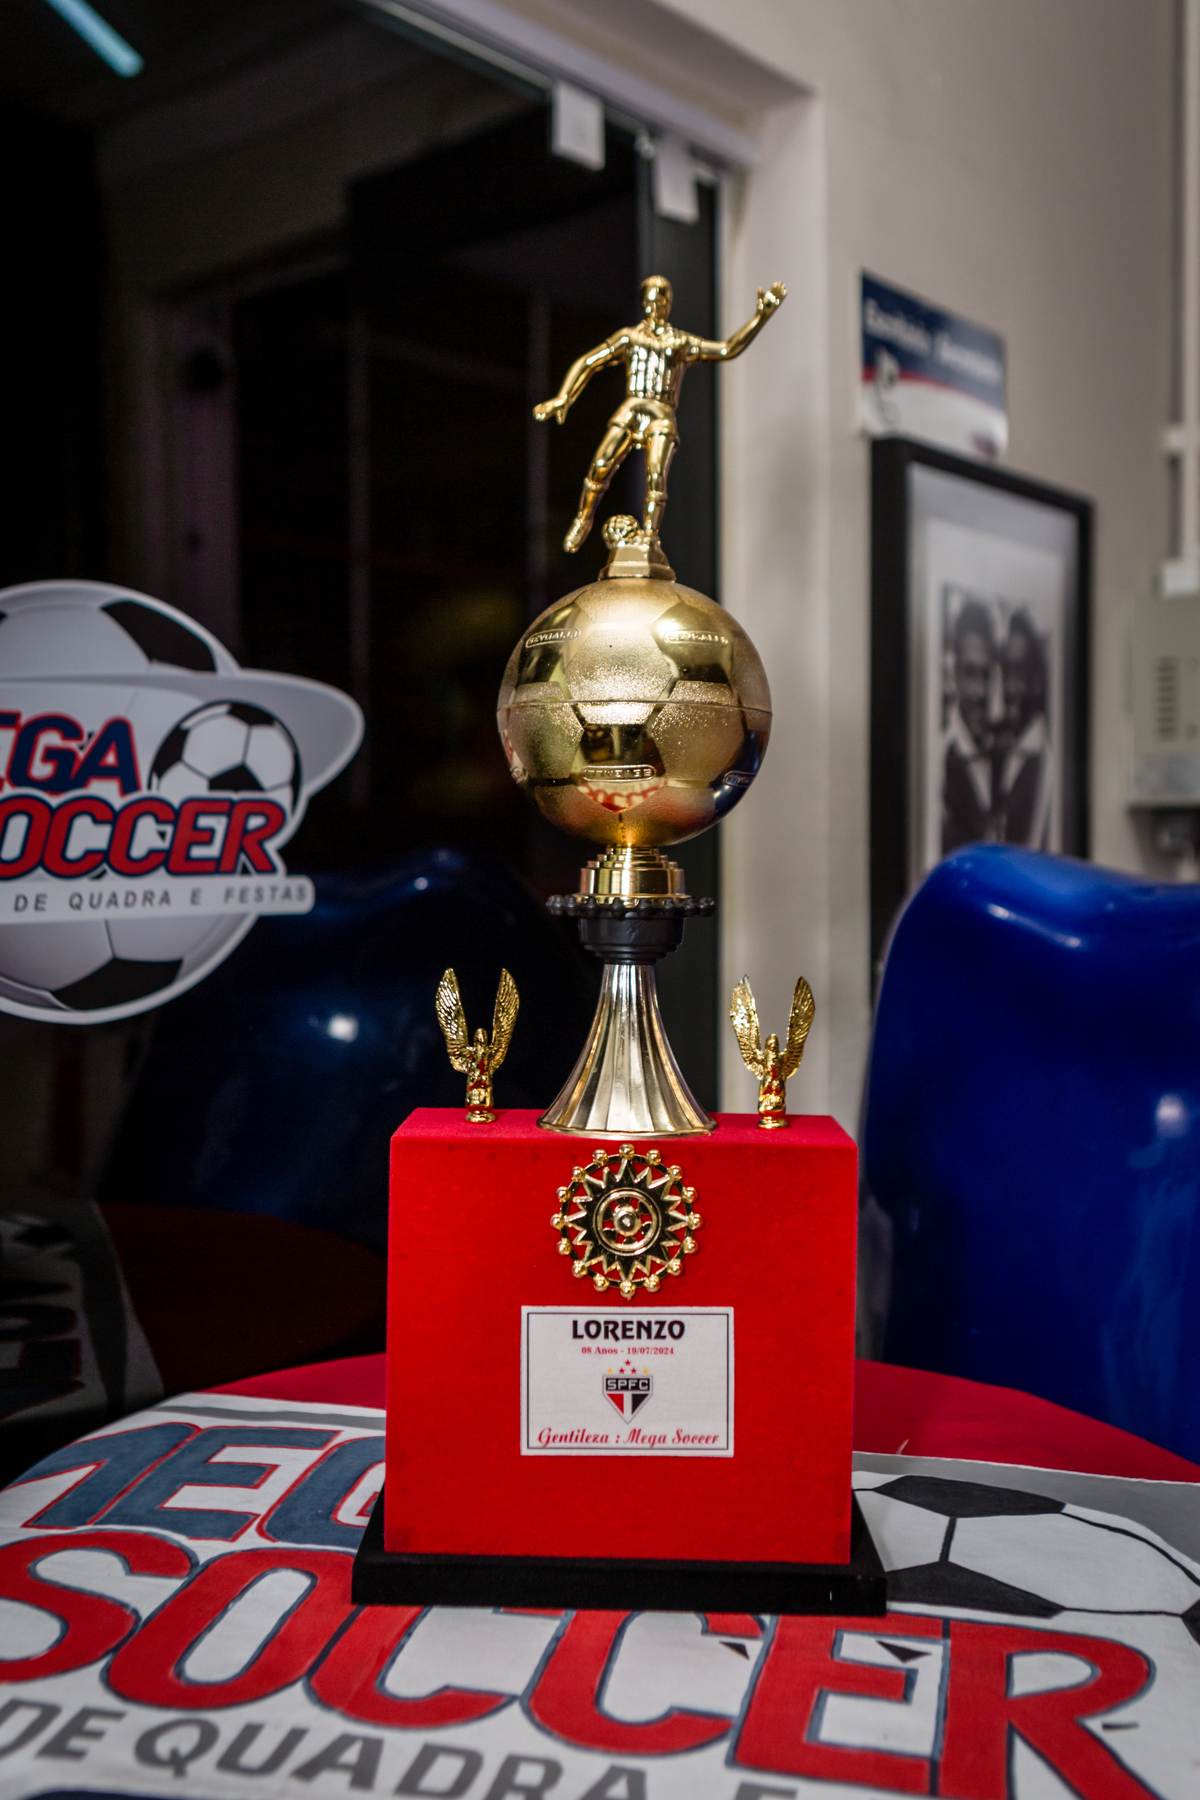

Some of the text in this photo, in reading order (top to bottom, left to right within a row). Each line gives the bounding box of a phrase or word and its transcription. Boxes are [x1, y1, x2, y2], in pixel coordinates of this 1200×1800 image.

[0, 709, 142, 797] GA
[0, 794, 287, 881] OCCER
[14, 884, 308, 912] DE QUADRA E FESTAS
[572, 1319, 686, 1342] LORENZO
[581, 1346, 592, 1355] 08
[594, 1346, 618, 1355] Anos
[627, 1346, 674, 1356] 19/07/2024
[607, 1379, 649, 1390] SPFC
[536, 1427, 610, 1448] Gentileza
[623, 1427, 667, 1448] Mega
[671, 1428, 720, 1445] Soccer
[0, 1530, 1164, 1800] SOCCER
[0, 1698, 127, 1762] DE
